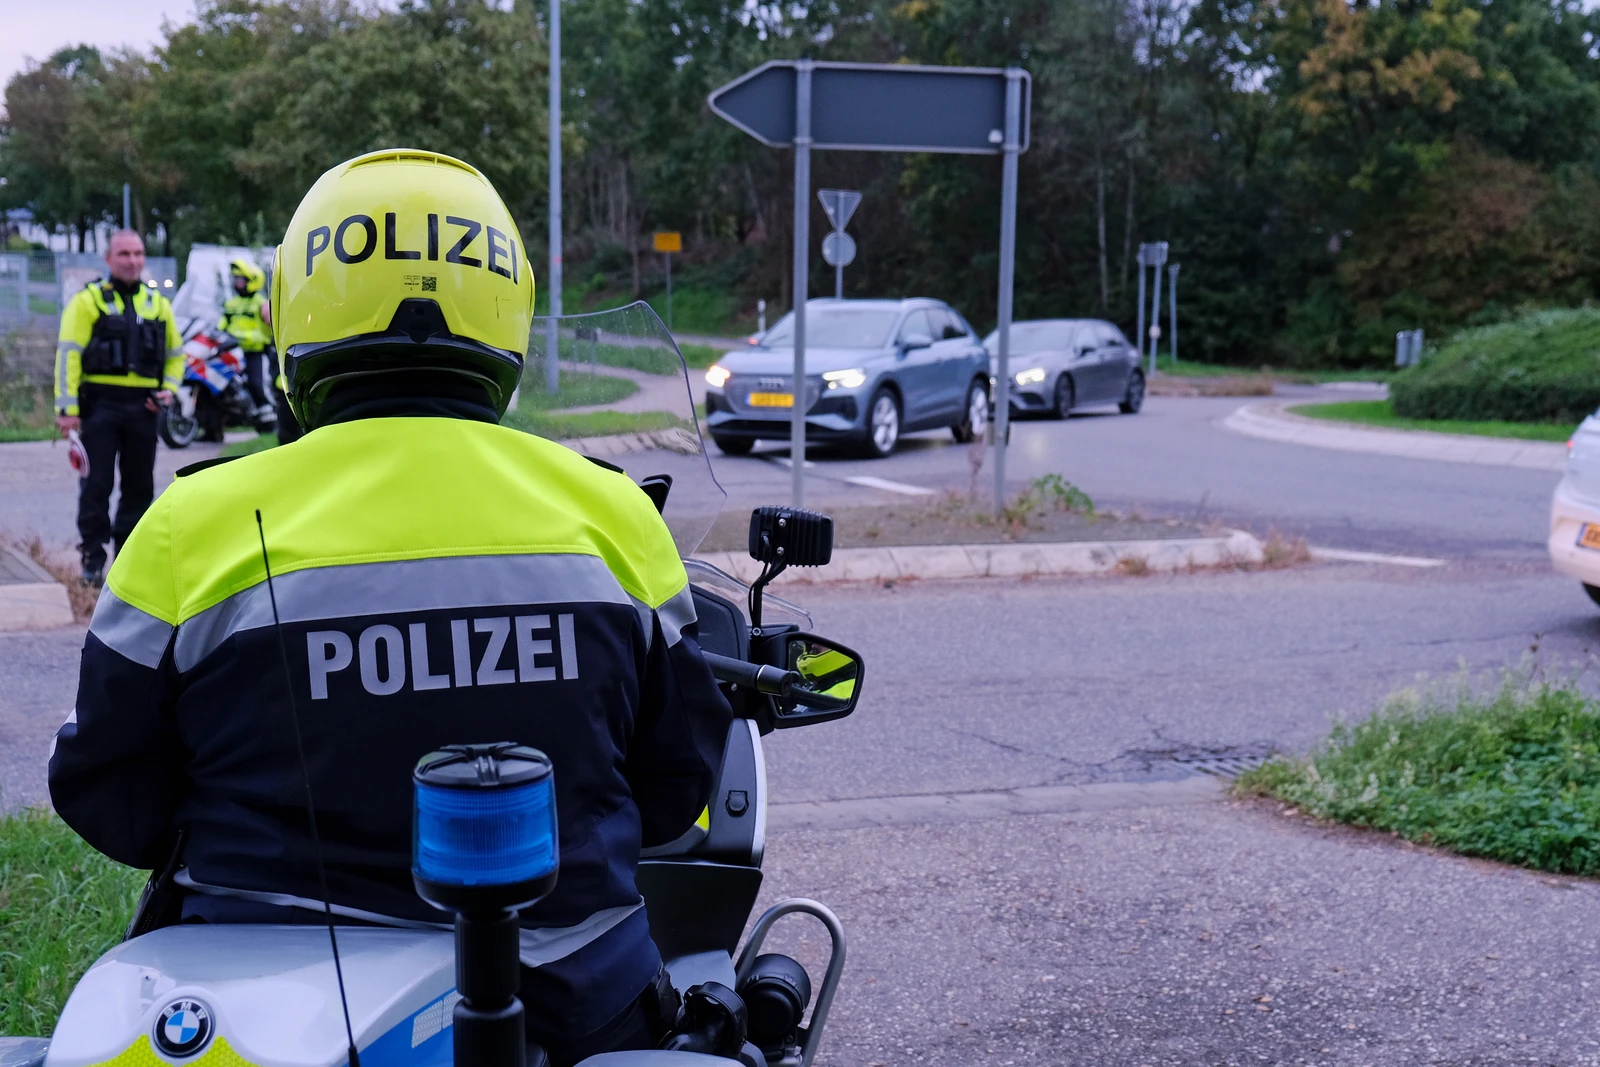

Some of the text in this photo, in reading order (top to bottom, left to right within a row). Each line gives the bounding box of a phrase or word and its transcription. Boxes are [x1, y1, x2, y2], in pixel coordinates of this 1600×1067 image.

[306, 212, 518, 285] POLIZEI
[306, 613, 579, 700] POLIZEI
[163, 1001, 207, 1020] BMW
